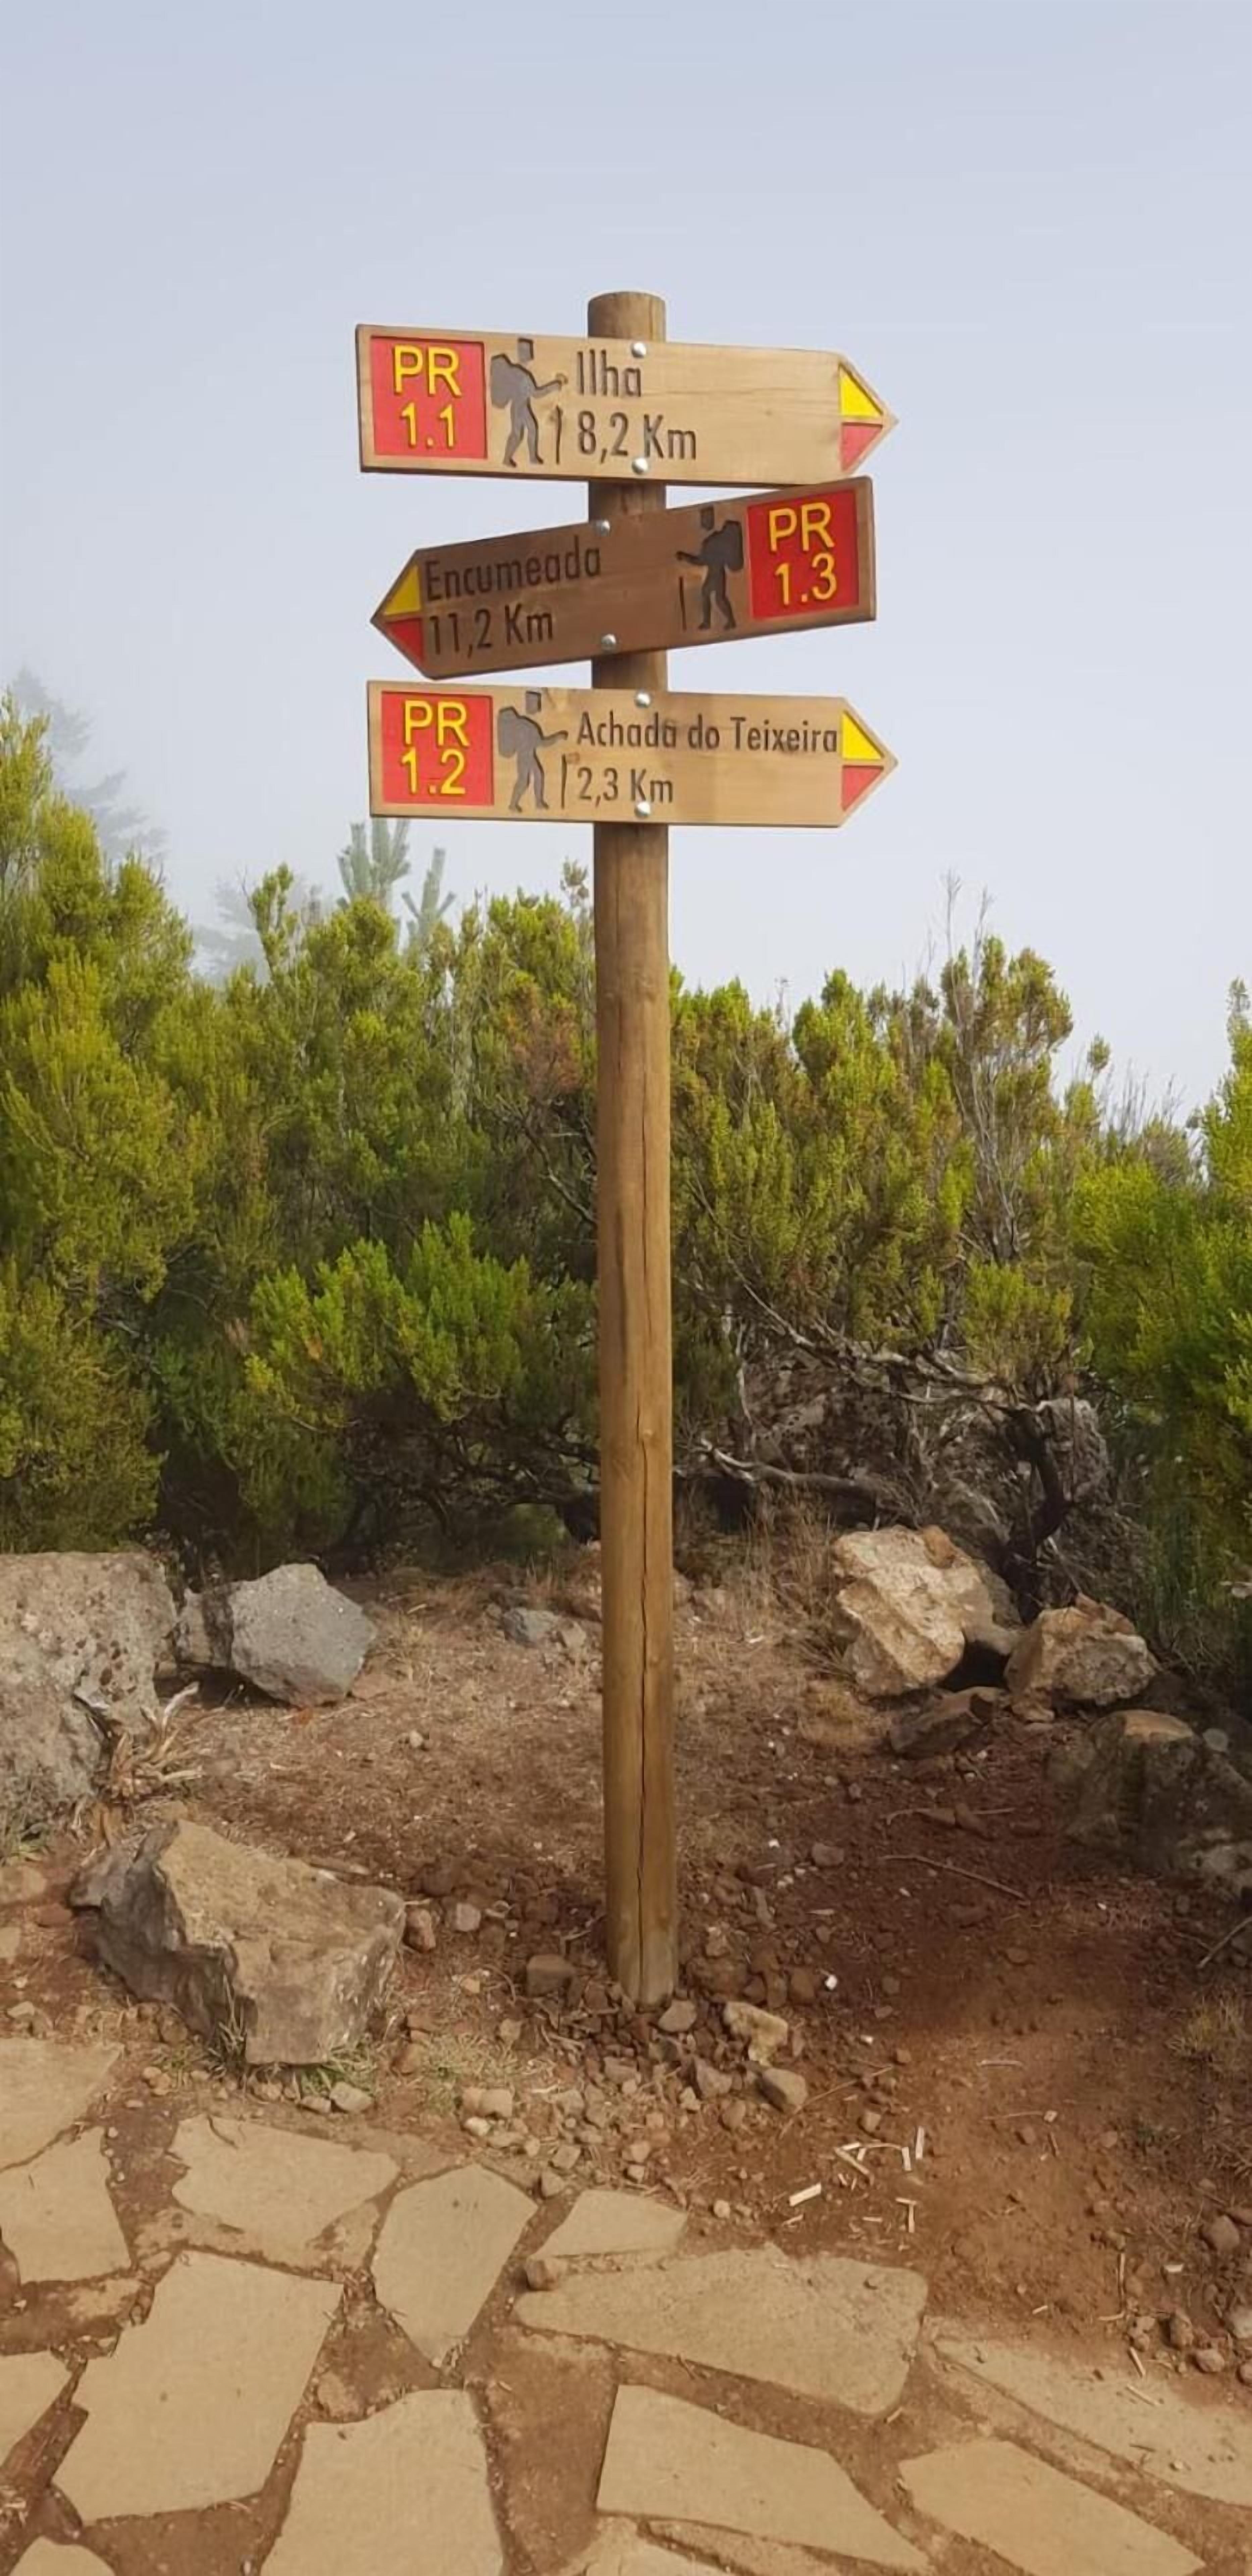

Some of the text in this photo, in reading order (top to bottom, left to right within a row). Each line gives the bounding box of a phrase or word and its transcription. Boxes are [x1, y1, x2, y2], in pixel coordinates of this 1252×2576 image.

[392, 344, 462, 396] PR
[577, 349, 641, 397] Ilha
[401, 402, 455, 448] 1.1
[577, 411, 697, 464] 8,2 Km
[769, 502, 835, 552] PR
[424, 535, 601, 601] Encumeada
[775, 552, 837, 606] 1.3
[429, 604, 554, 658] 11,2 Km
[404, 700, 469, 747] PR
[576, 709, 838, 753] Achada do Teixeira
[401, 748, 466, 795] 1.2
[577, 766, 674, 807] 2,3 Km
